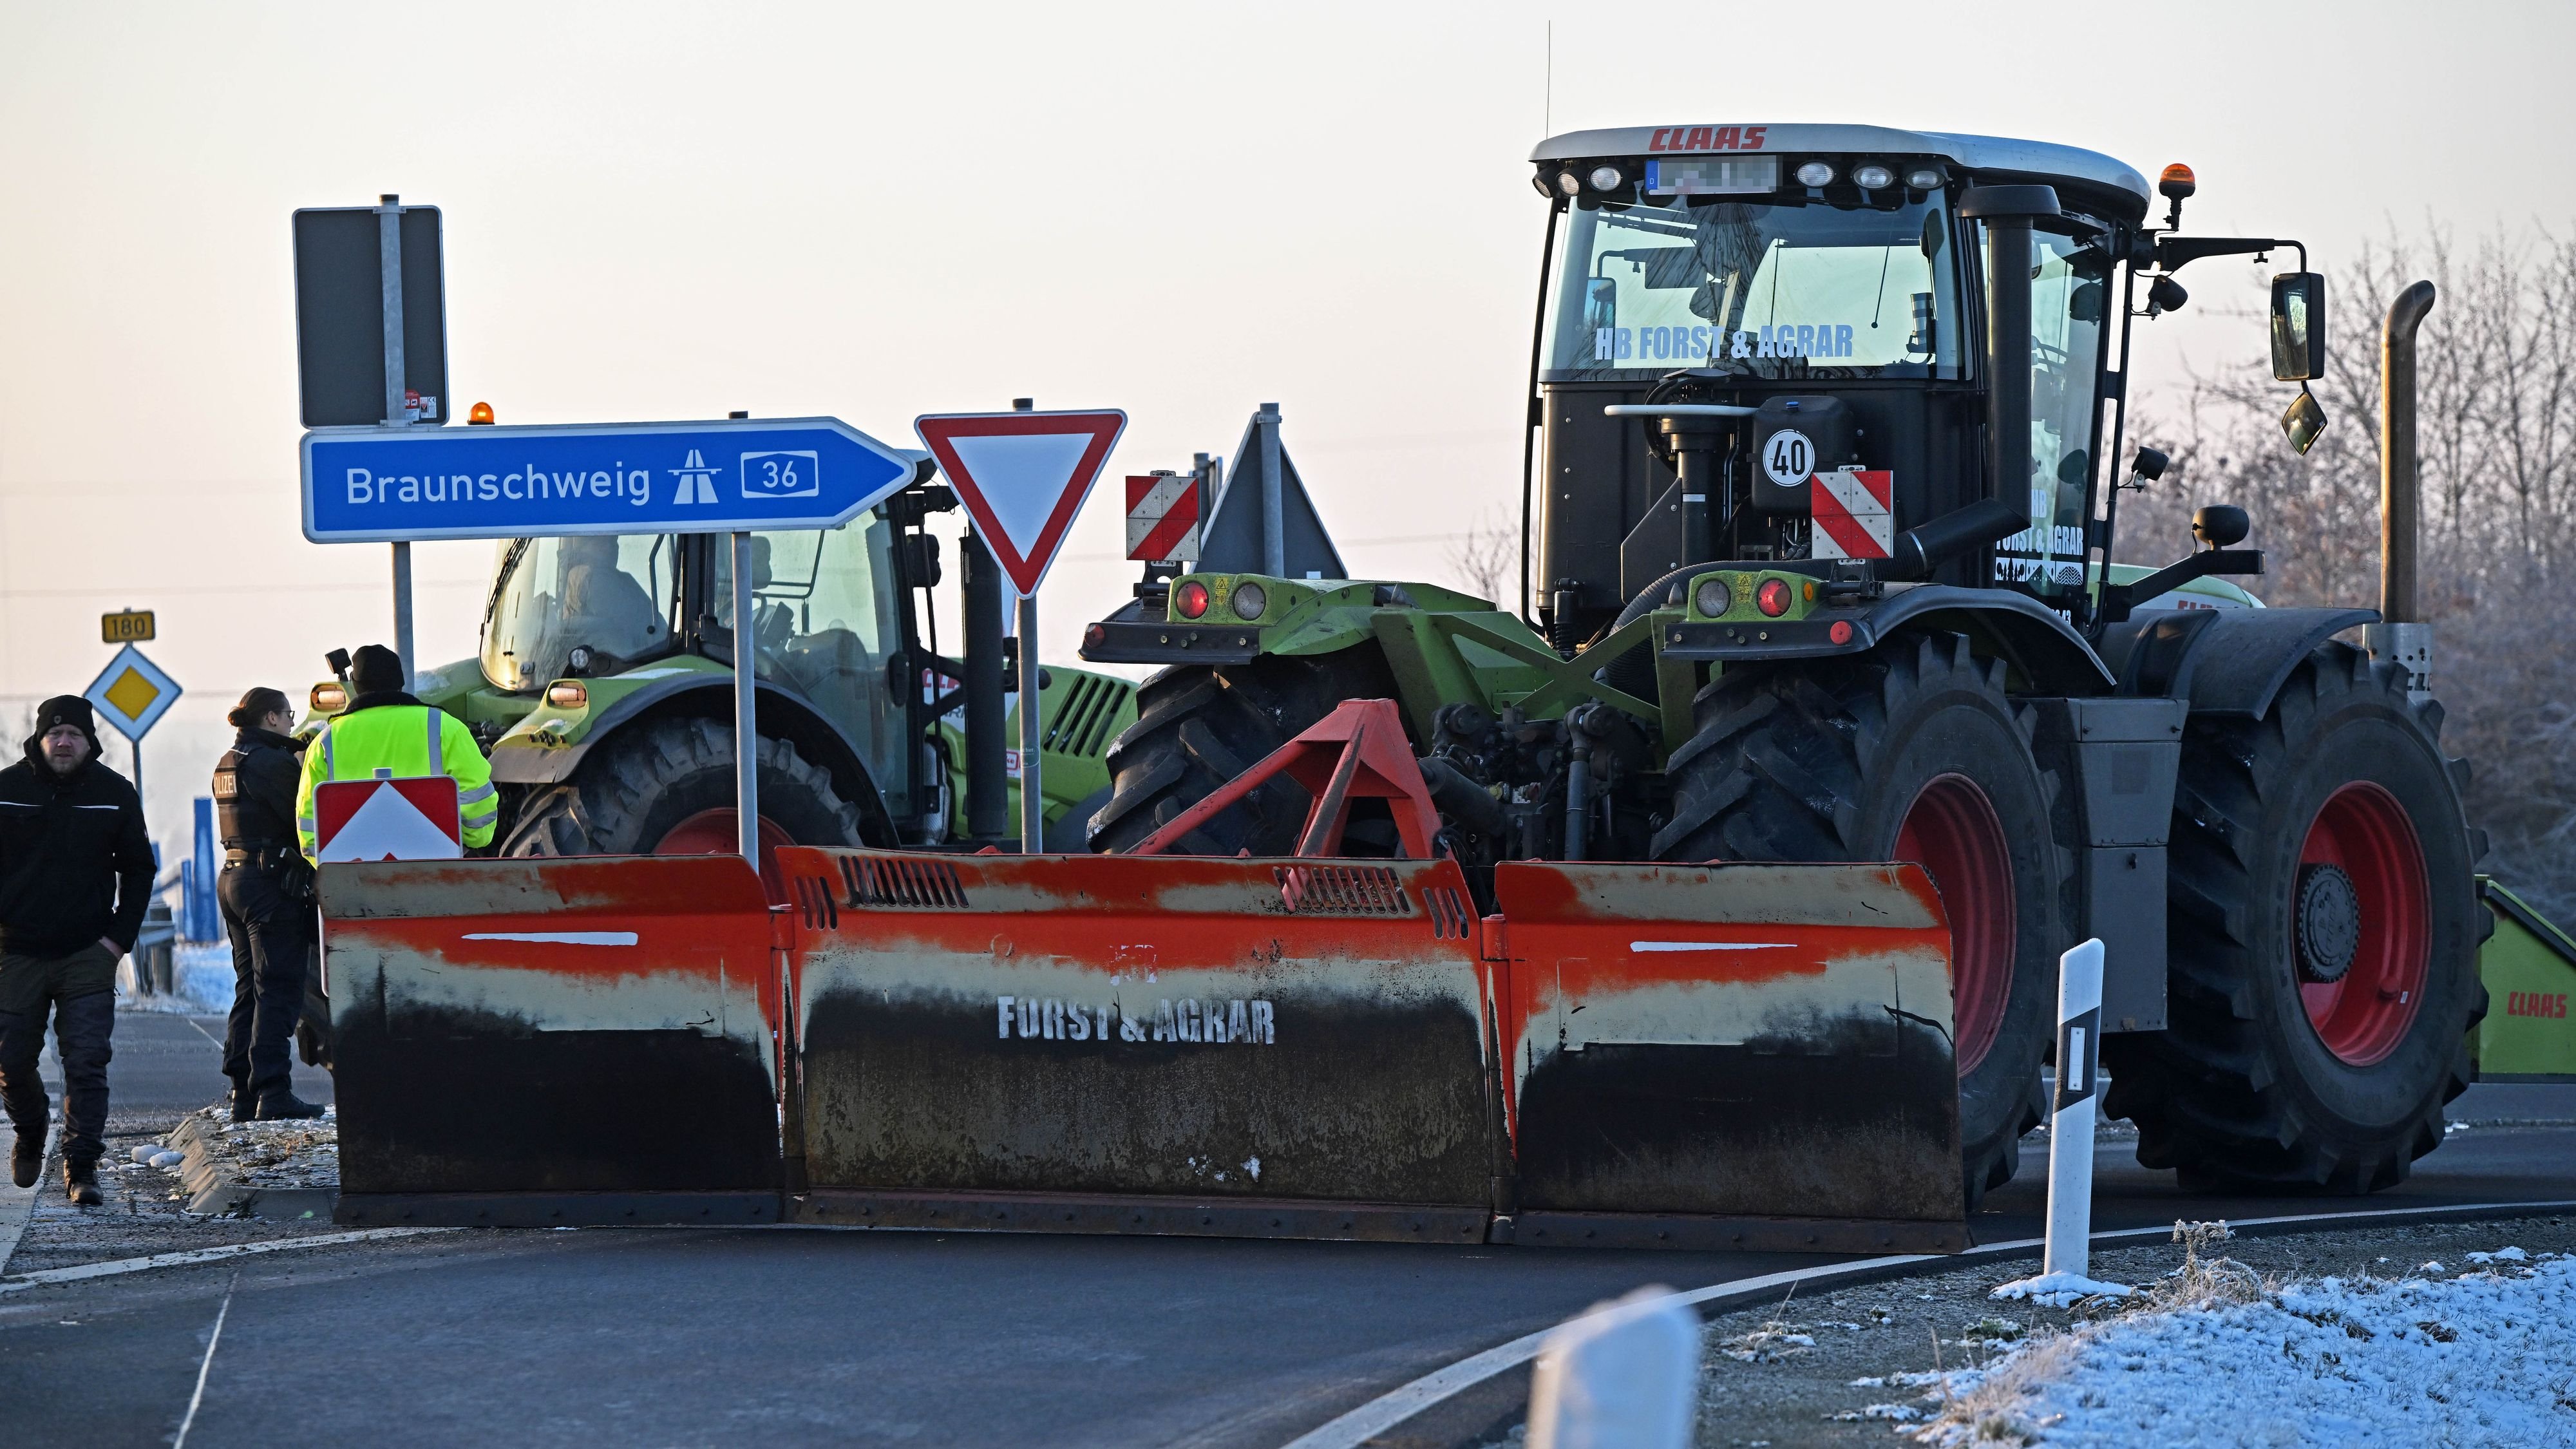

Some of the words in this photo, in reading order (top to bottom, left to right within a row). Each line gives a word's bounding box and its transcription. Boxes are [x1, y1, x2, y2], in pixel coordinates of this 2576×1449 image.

[1649, 127, 1767, 150] CLAAS
[1595, 327, 1631, 360] HB
[1639, 326, 1725, 359] FORST
[1730, 330, 1752, 359] &
[1758, 324, 1853, 358] AGRAR
[1773, 440, 1805, 475] 40
[346, 462, 650, 507] Braunschweig
[762, 460, 798, 489] 36
[2031, 489, 2047, 518] HB
[2036, 528, 2045, 553] &
[2047, 525, 2083, 556] AGRAR
[111, 617, 146, 636] 180
[214, 775, 237, 794] OLIZEI
[2508, 991, 2568, 1018] CLAAS
[998, 996, 1108, 1040] FORST
[1153, 998, 1276, 1045] AGRAR
